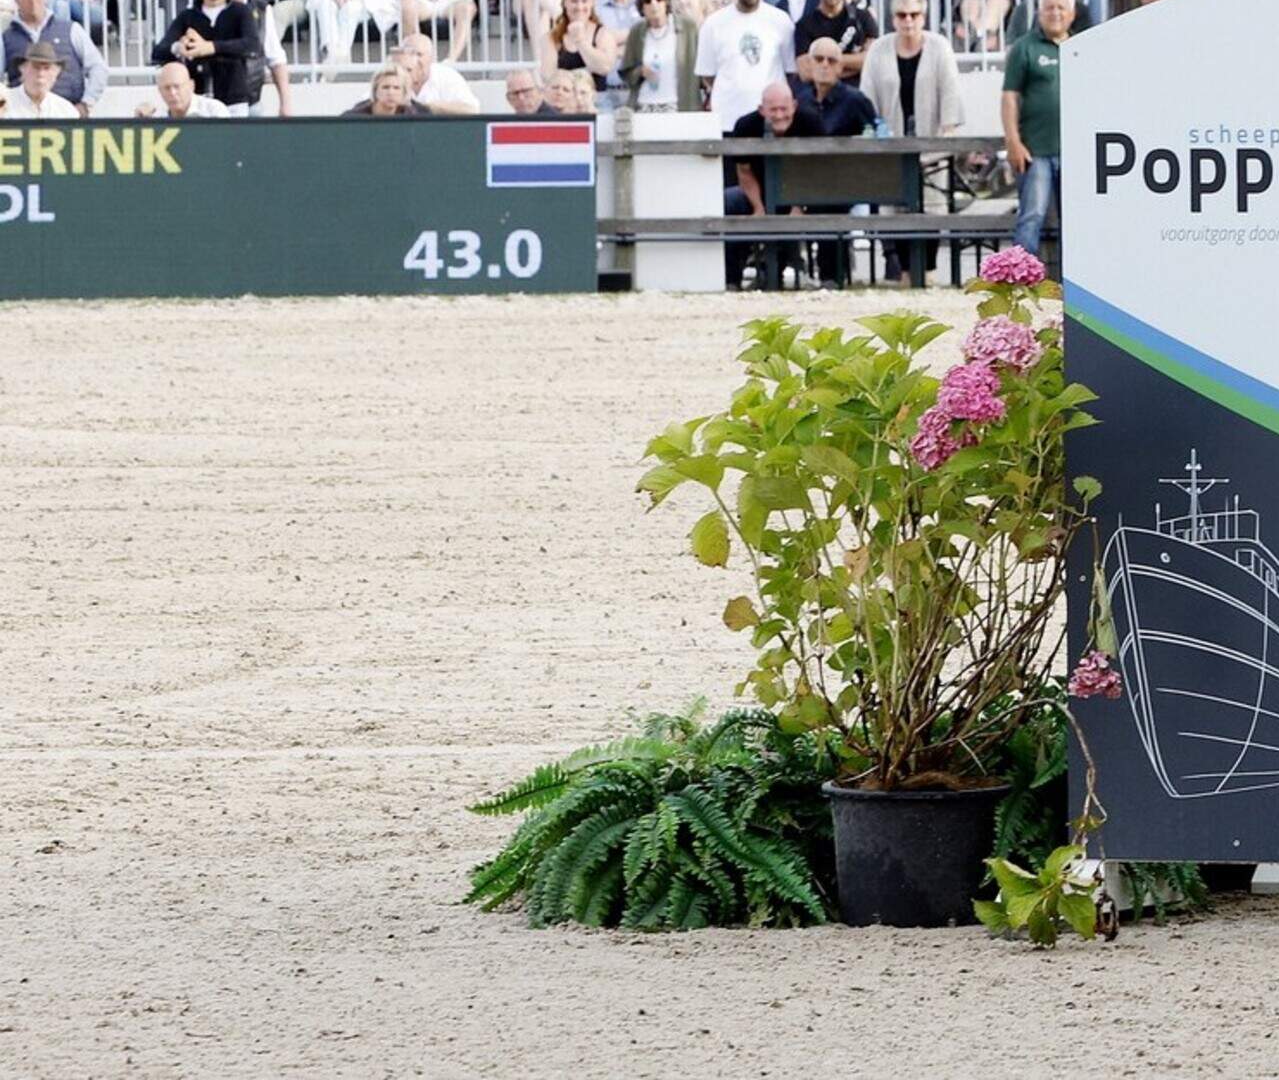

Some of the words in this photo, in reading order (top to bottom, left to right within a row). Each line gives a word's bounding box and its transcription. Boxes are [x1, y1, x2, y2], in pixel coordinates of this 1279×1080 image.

[0, 128, 183, 175] ERINK
[403, 229, 543, 279] 43.0
[1160, 226, 1245, 245] vooruitgang
